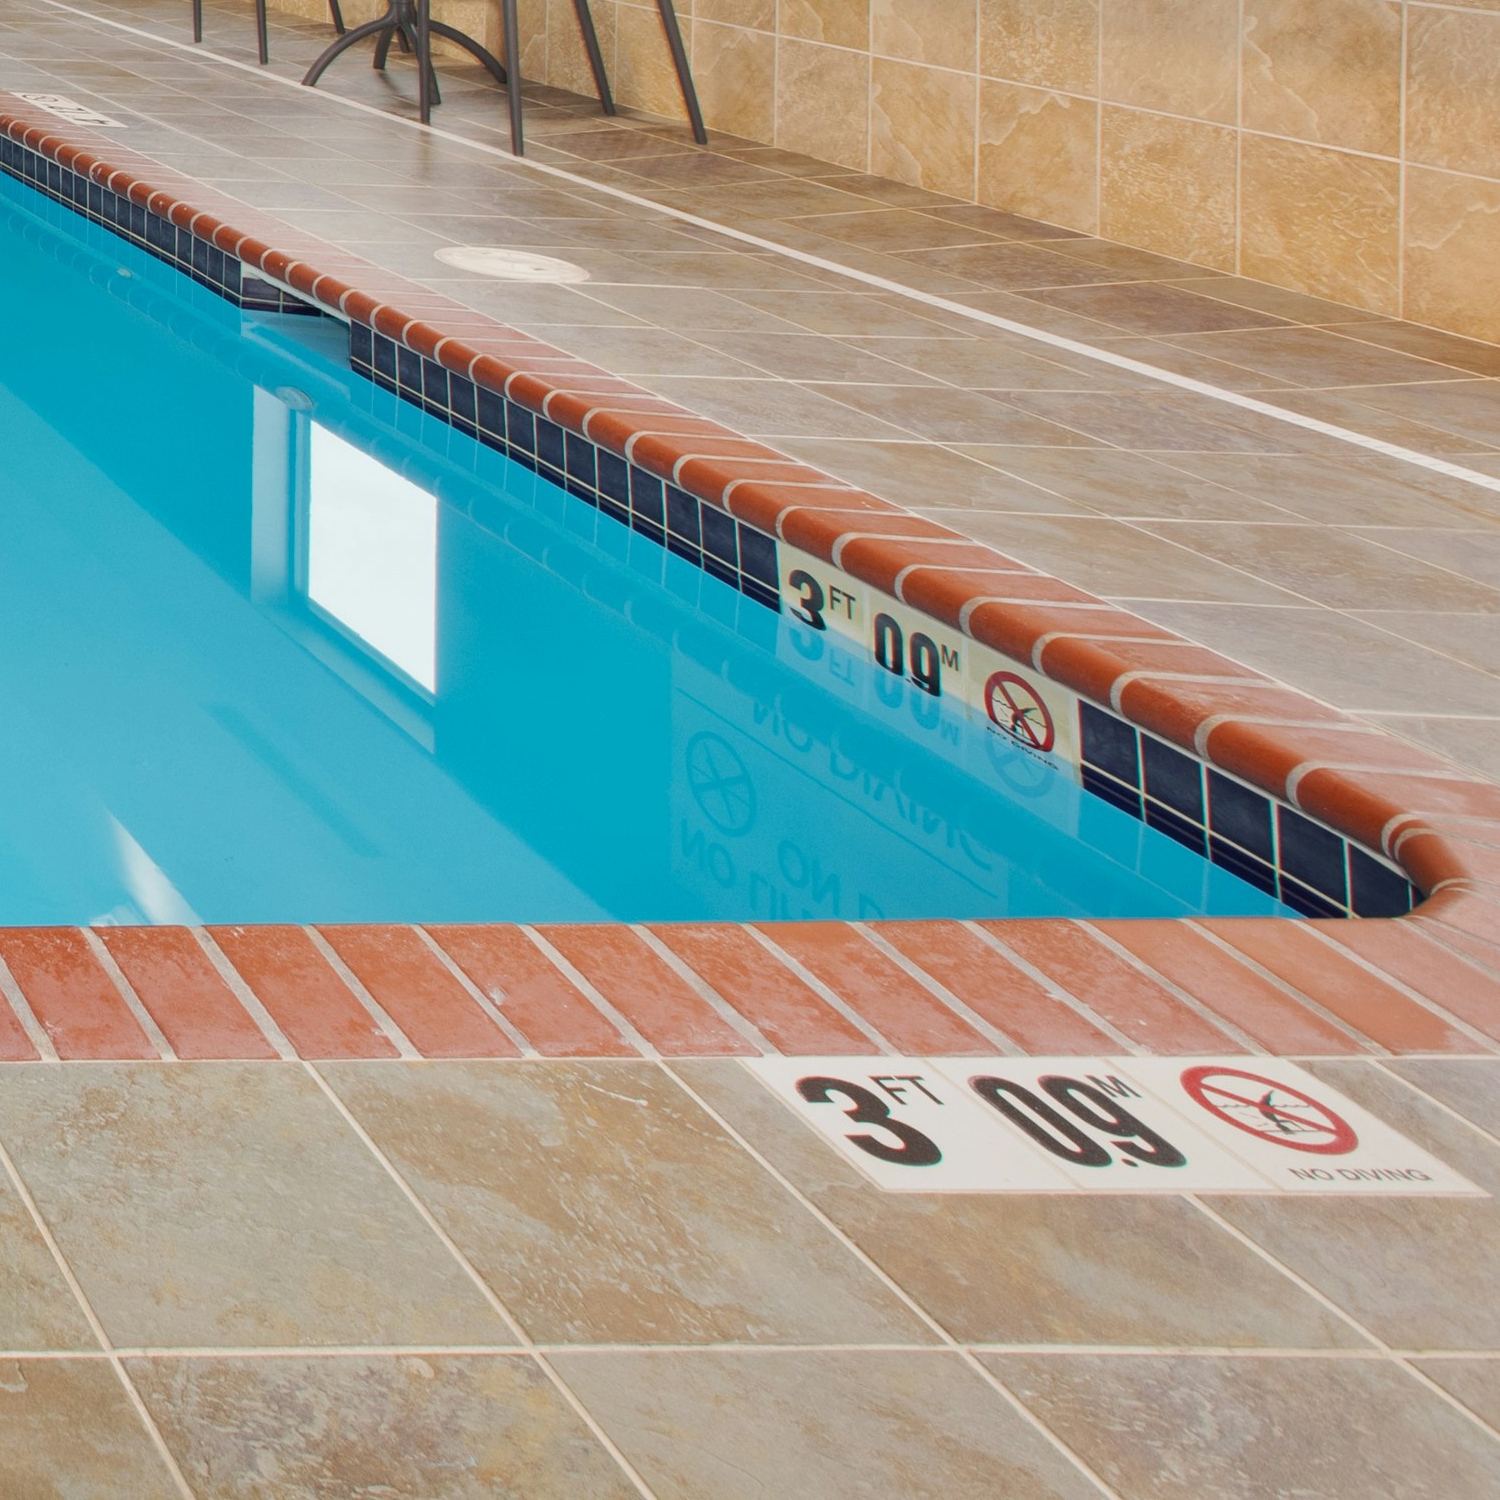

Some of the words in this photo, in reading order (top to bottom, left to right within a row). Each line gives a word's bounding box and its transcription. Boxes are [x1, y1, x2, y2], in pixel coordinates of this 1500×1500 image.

[789, 569, 827, 631] 3
[829, 585, 855, 620] FT
[941, 644, 959, 671] M
[867, 1074, 945, 1106] FT
[1084, 1074, 1143, 1099] M
[795, 1076, 943, 1167] 3
[967, 1074, 1188, 1168] 0.9
[1287, 1167, 1335, 1181] NO
[1334, 1167, 1434, 1181] DIVING
